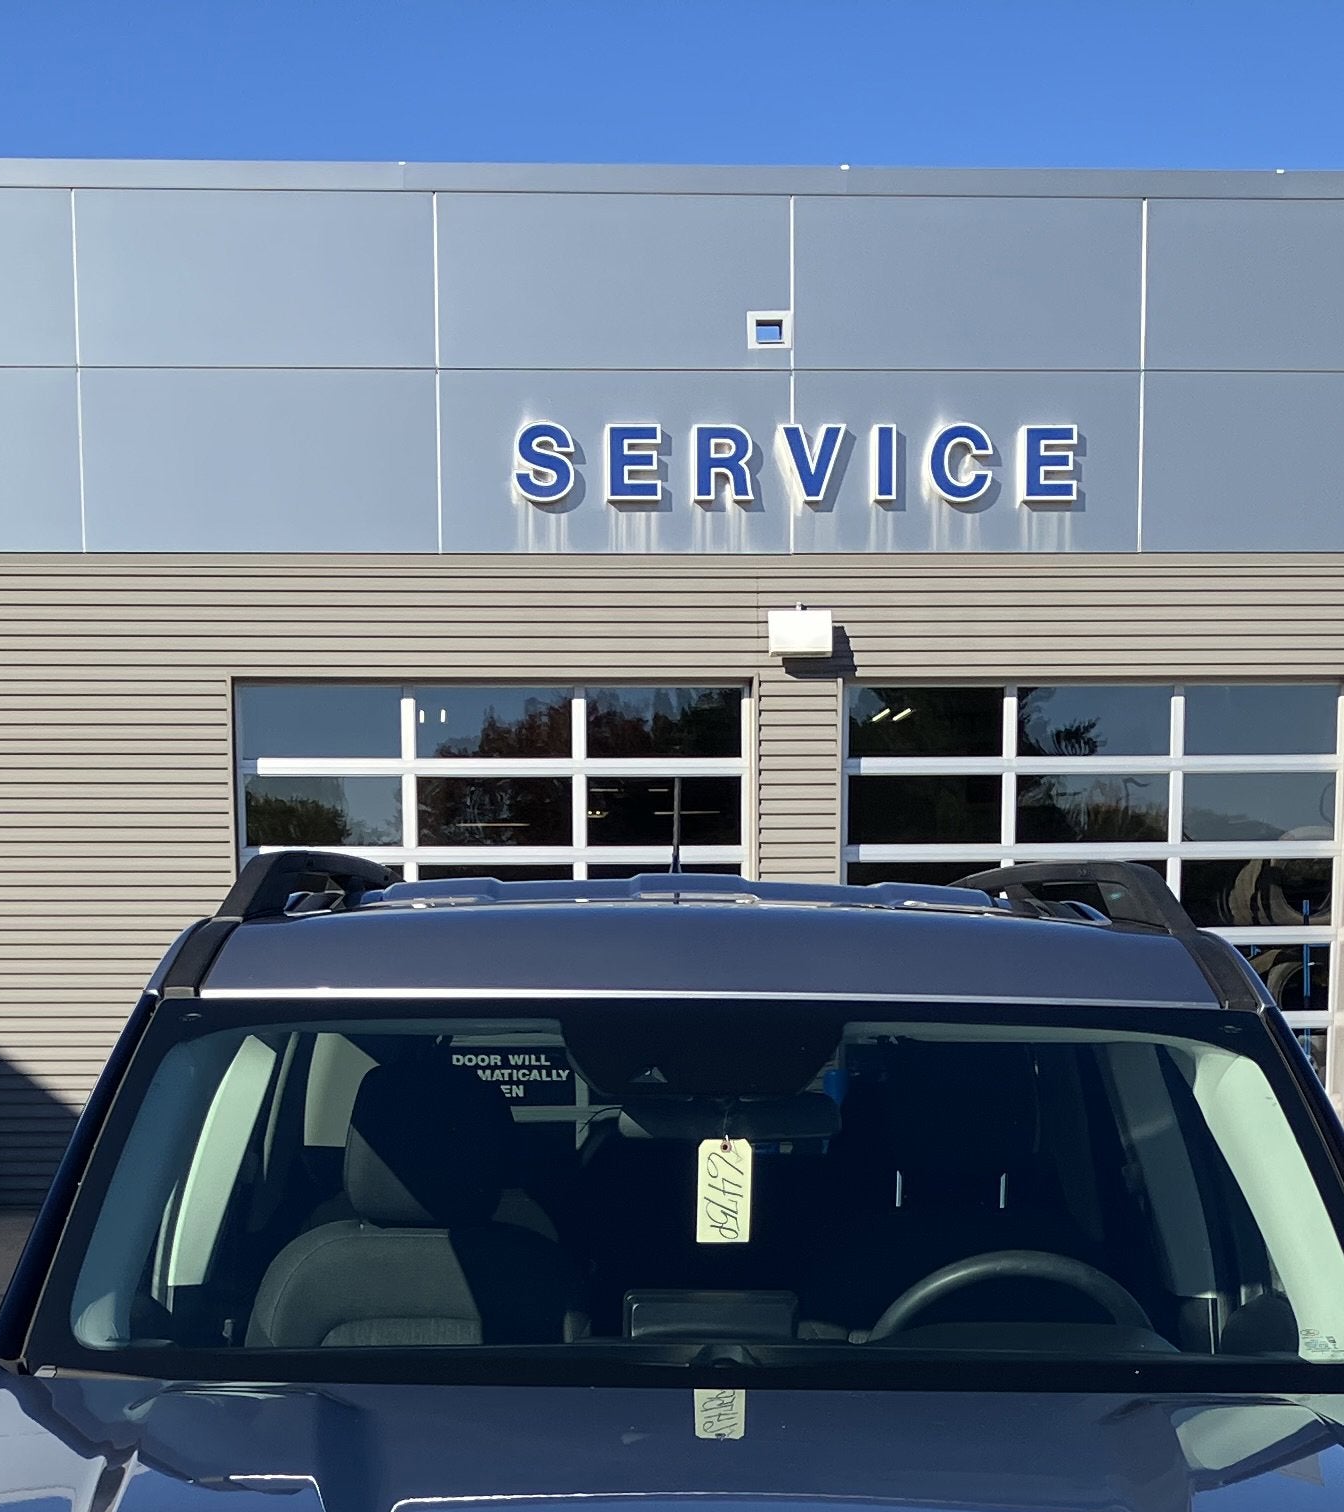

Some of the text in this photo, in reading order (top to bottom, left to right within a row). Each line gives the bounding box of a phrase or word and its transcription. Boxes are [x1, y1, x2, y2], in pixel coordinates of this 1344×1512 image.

[513, 420, 1078, 502] SERVICE
[452, 1054, 551, 1066] DOOR WILL
[477, 1069, 570, 1081] MATICALLY
[500, 1085, 524, 1097] EN
